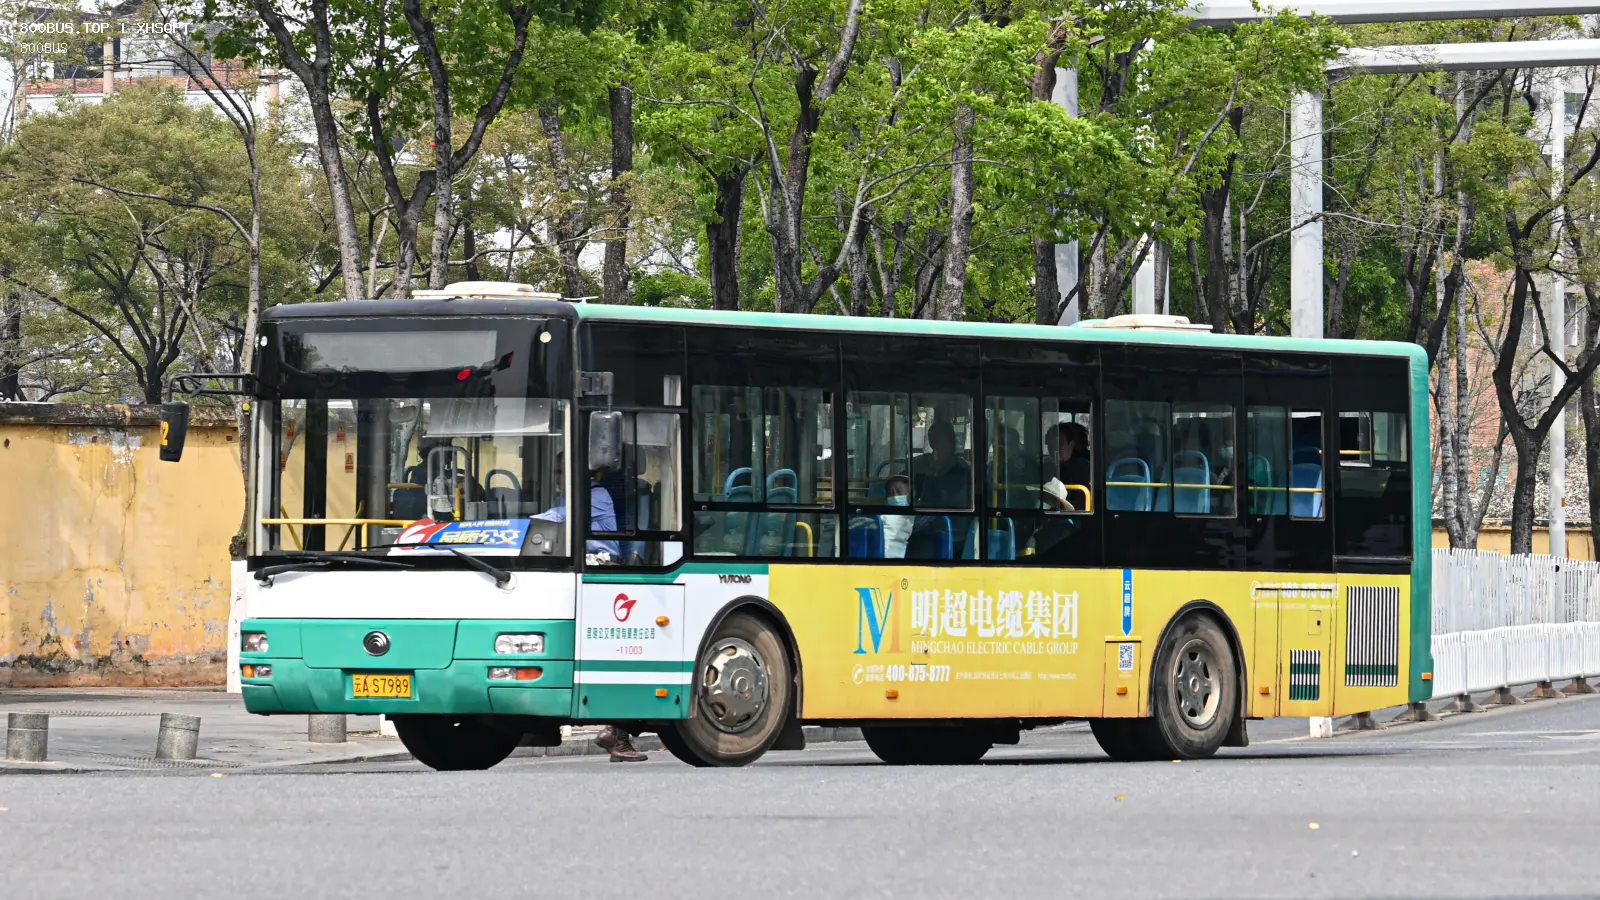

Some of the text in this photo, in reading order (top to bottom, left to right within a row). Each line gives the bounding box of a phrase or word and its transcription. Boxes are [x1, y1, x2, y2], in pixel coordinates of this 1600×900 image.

[439, 529, 521, 545] 品质公交
[718, 574, 752, 584] YUTONG
[911, 589, 1079, 639] 明超电缆集团
[911, 640, 1079, 656] MINGCHAO ELECTRIC CABLE GROUP
